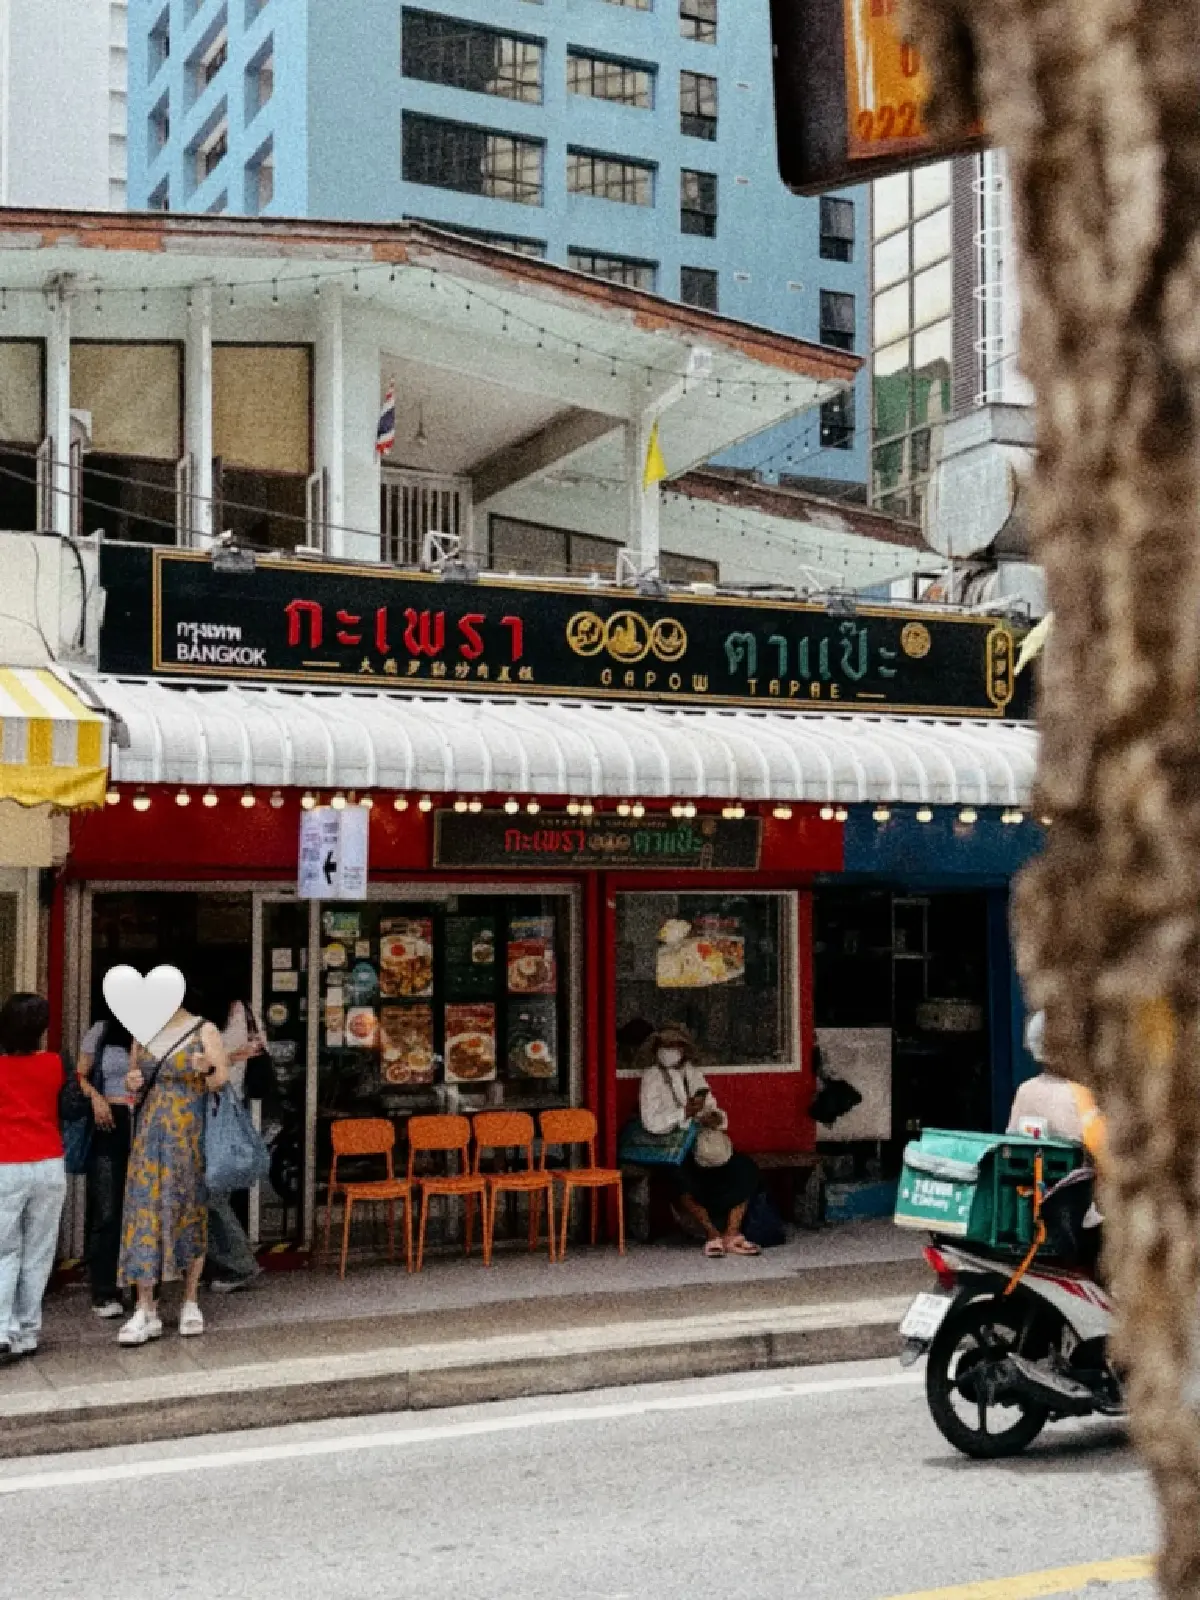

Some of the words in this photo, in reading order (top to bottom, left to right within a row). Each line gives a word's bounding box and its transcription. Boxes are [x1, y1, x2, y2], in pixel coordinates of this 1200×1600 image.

[177, 642, 267, 667] BANGKOK
[284, 599, 523, 662] กะเพรา
[724, 621, 898, 681] ตาแป๊ะ
[601, 667, 708, 692] GAPOW
[748, 679, 841, 699] TAPAE
